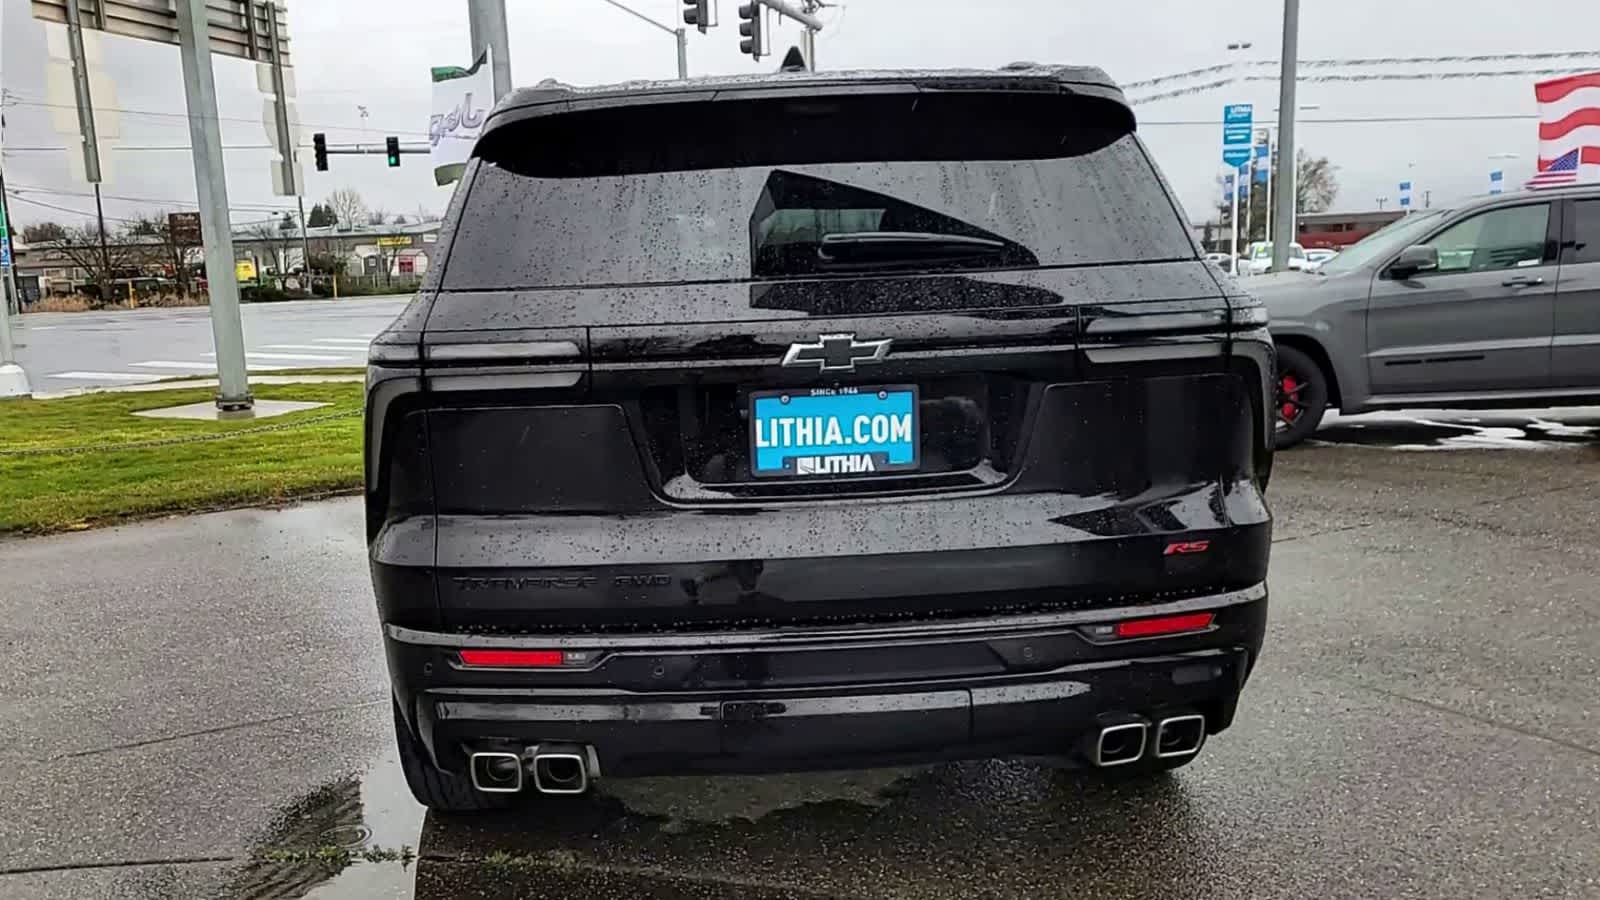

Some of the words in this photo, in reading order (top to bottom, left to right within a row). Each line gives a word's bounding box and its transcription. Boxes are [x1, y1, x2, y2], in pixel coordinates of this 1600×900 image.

[810, 388, 836, 396] SINCE
[756, 414, 912, 447] LITHIA.COM
[816, 454, 875, 473] LITHIA
[1163, 540, 1210, 555] RS
